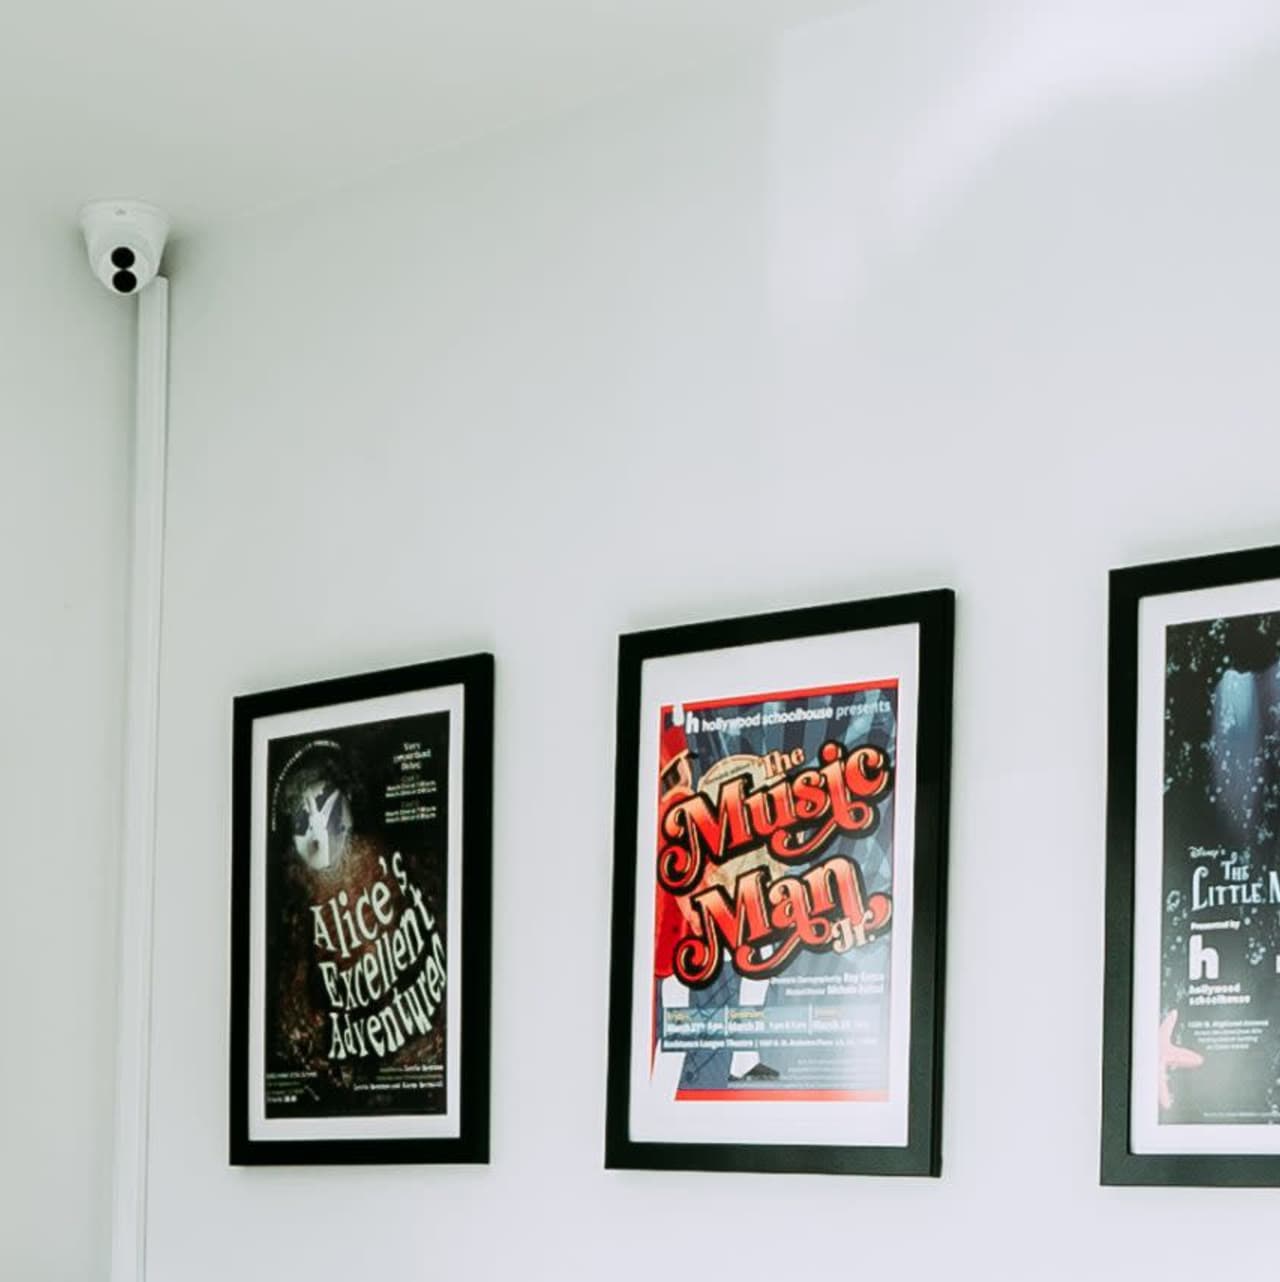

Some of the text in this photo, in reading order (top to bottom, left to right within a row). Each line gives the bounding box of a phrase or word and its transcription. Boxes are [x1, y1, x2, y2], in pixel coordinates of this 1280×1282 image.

[702, 700, 891, 735] hollywood schoolhouse presents
[658, 742, 888, 890] Music
[310, 851, 410, 959] Alice's
[674, 856, 892, 984] Man
[1191, 865, 1263, 912] LITTLE
[319, 884, 435, 1011] Excellent
[328, 932, 448, 1060] Adventures
[1189, 934, 1219, 981] h
[1189, 983, 1241, 995] hollywood
